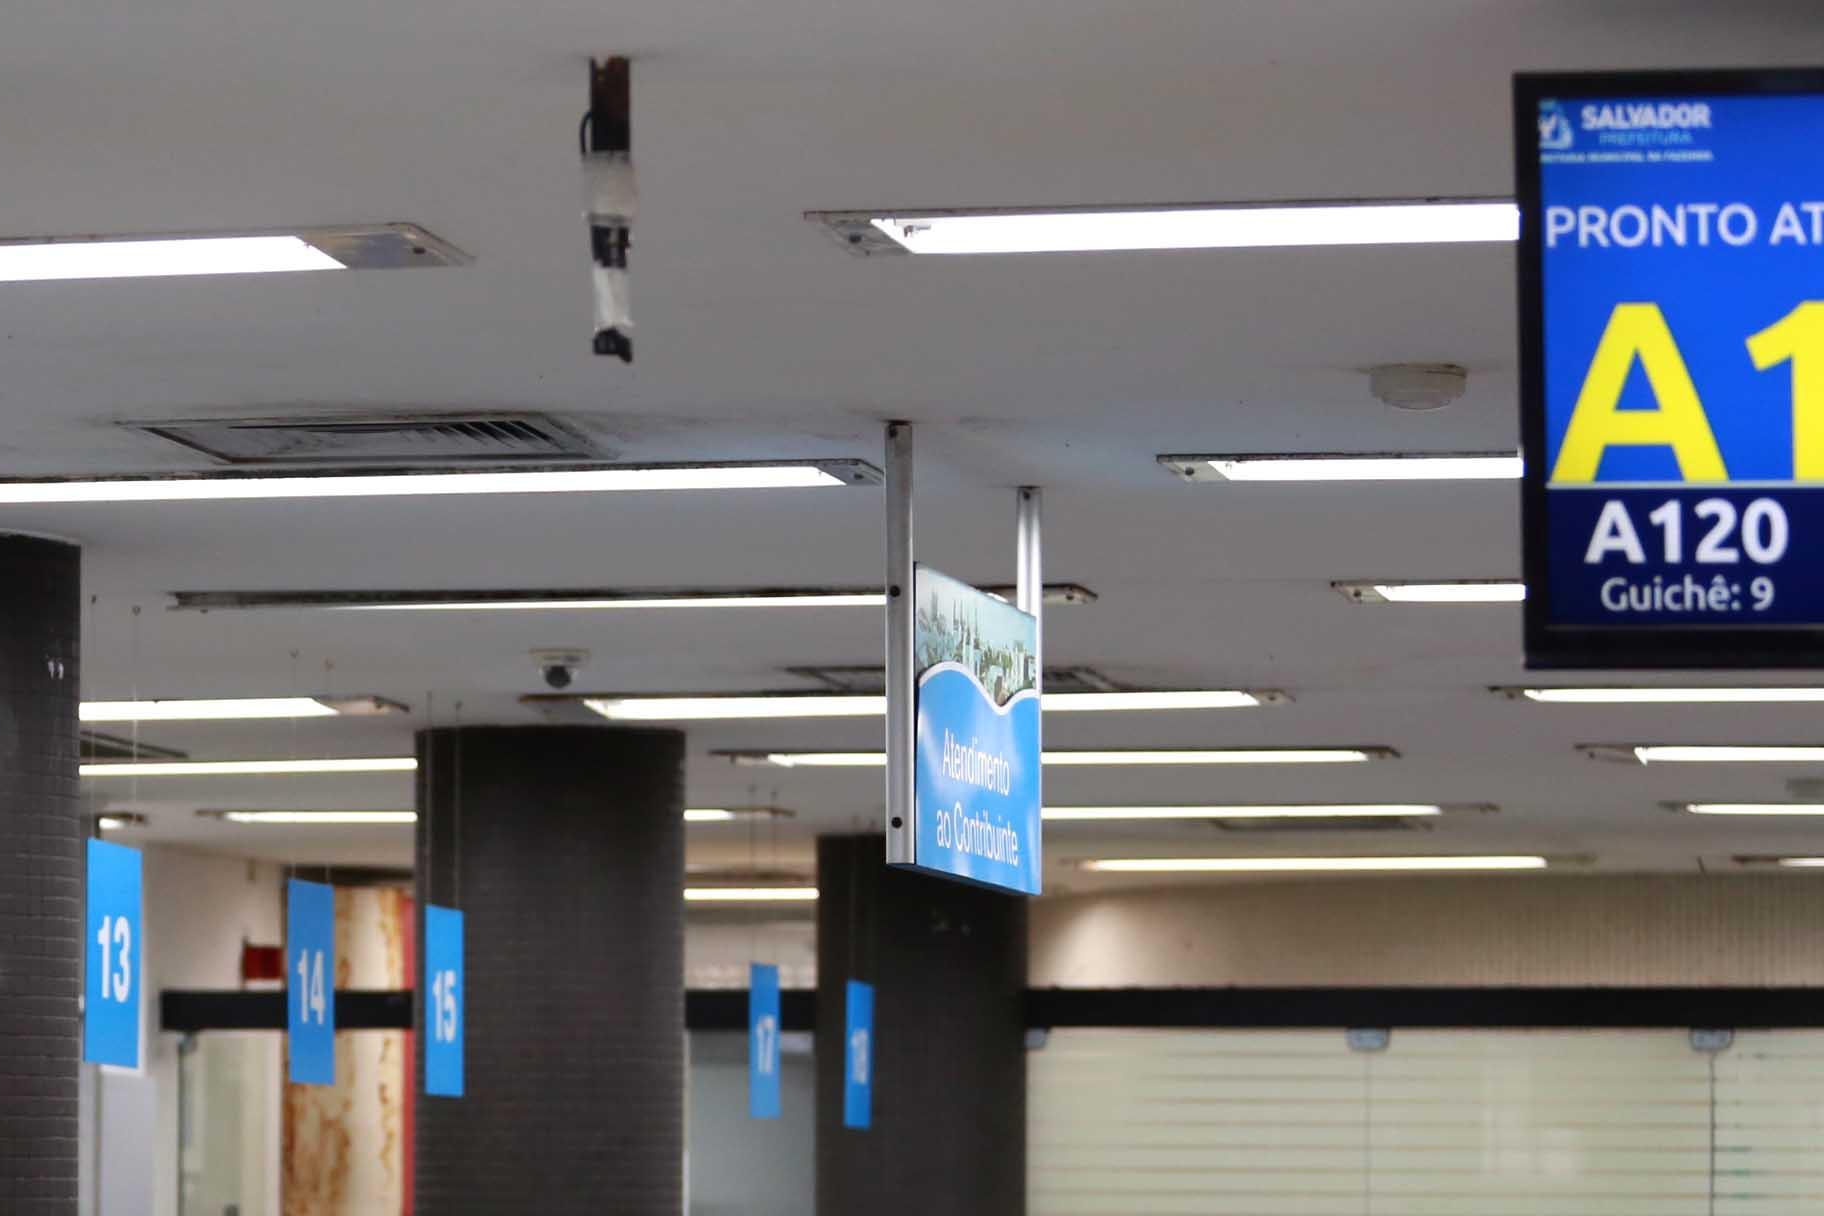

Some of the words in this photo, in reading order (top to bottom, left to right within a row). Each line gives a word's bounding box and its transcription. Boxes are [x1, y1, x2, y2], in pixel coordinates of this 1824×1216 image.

[1581, 103, 1712, 130] SALVADOR
[1546, 203, 1757, 247] PRONTO
[1584, 498, 1789, 565] A120
[1601, 575, 1741, 612] Guichê:
[1751, 577, 1775, 612] 9
[942, 727, 1010, 797] Atendimento
[936, 809, 952, 848] ao
[954, 801, 1019, 868] Contribuinte
[97, 915, 131, 1003] 13
[297, 948, 325, 1025] 14
[432, 968, 457, 1044] 15
